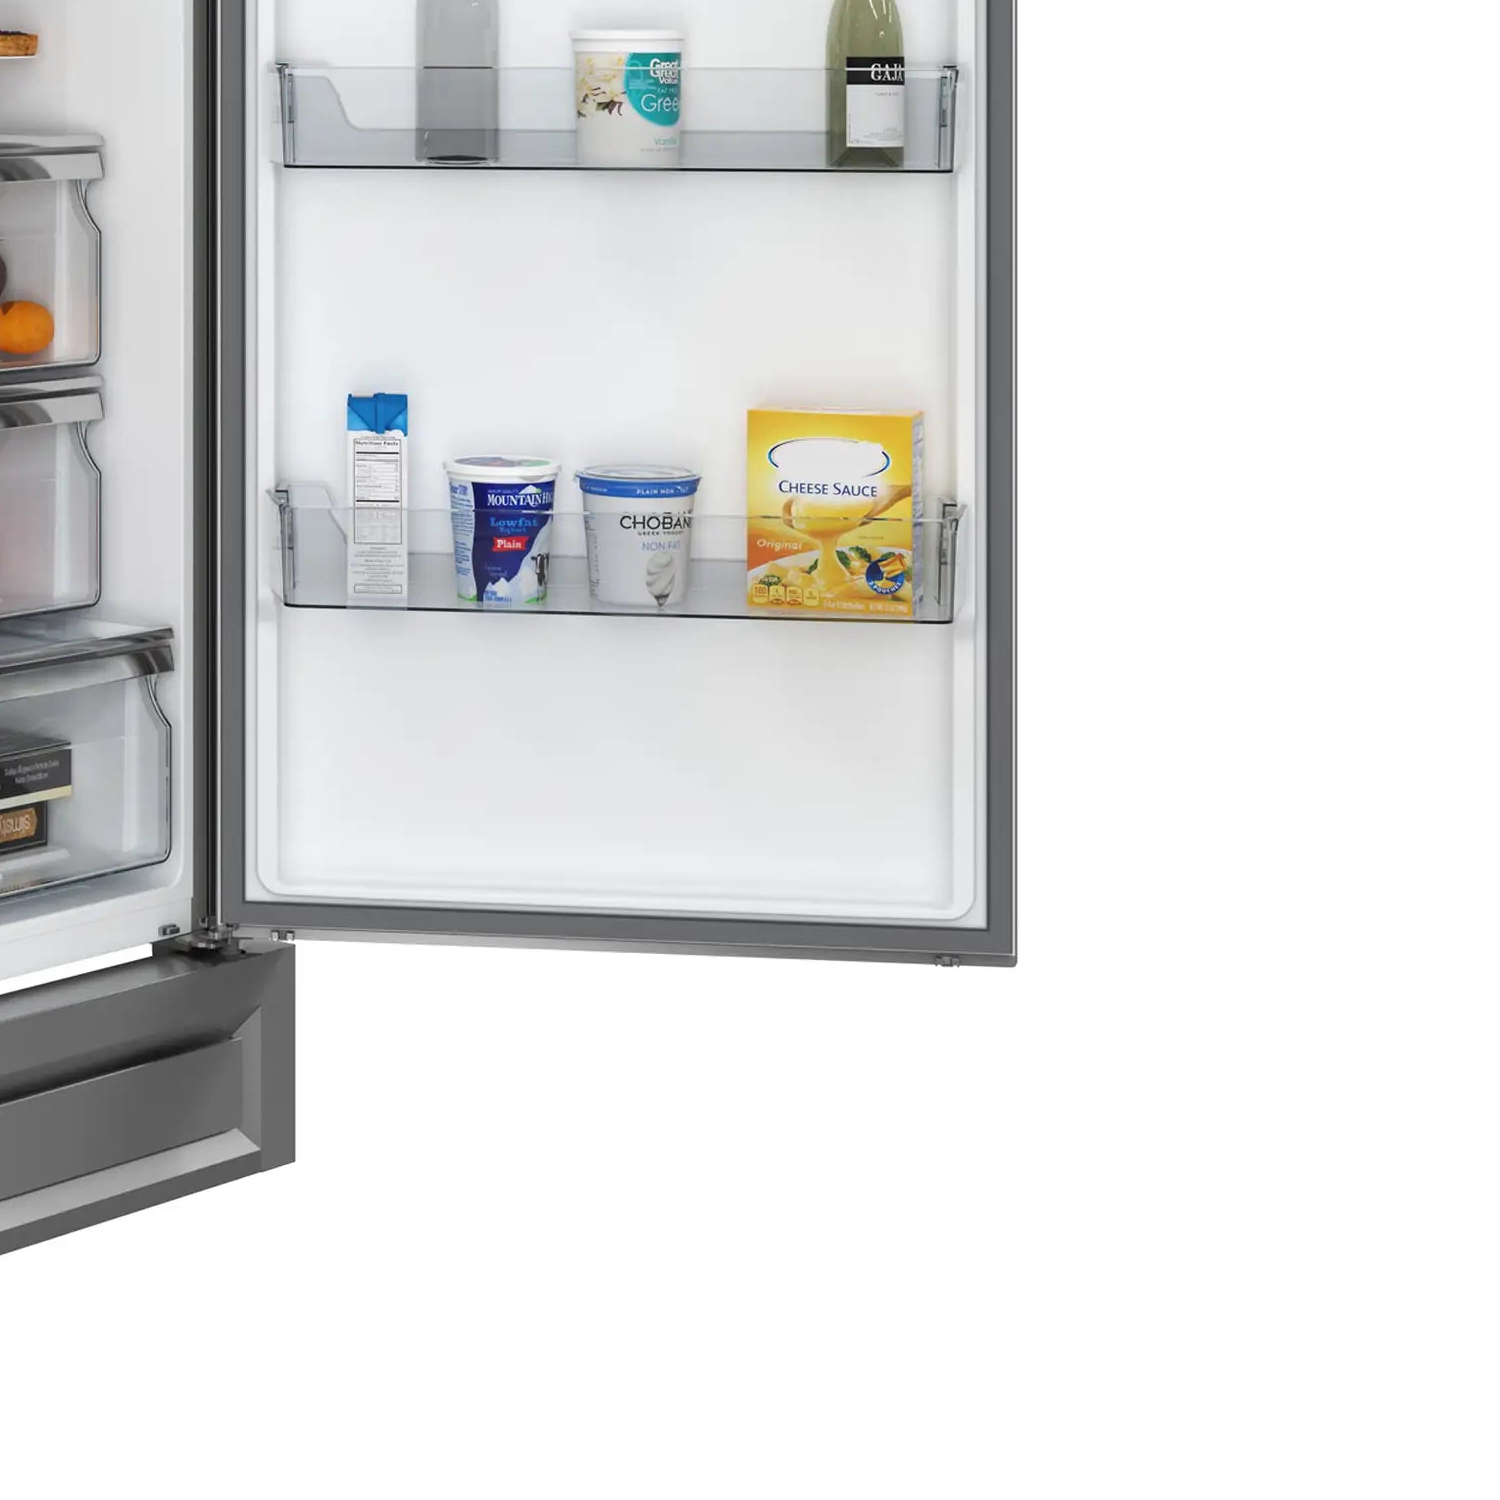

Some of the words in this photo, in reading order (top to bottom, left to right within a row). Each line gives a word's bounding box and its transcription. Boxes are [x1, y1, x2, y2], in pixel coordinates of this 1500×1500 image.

[778, 480, 829, 495] CHEESE
[833, 482, 878, 497] SAUCE
[487, 493, 542, 508] MOUNTAIN
[490, 517, 538, 527] Lowfat
[496, 539, 522, 549] Plain
[642, 541, 666, 552] NON
[756, 538, 803, 551] Original
